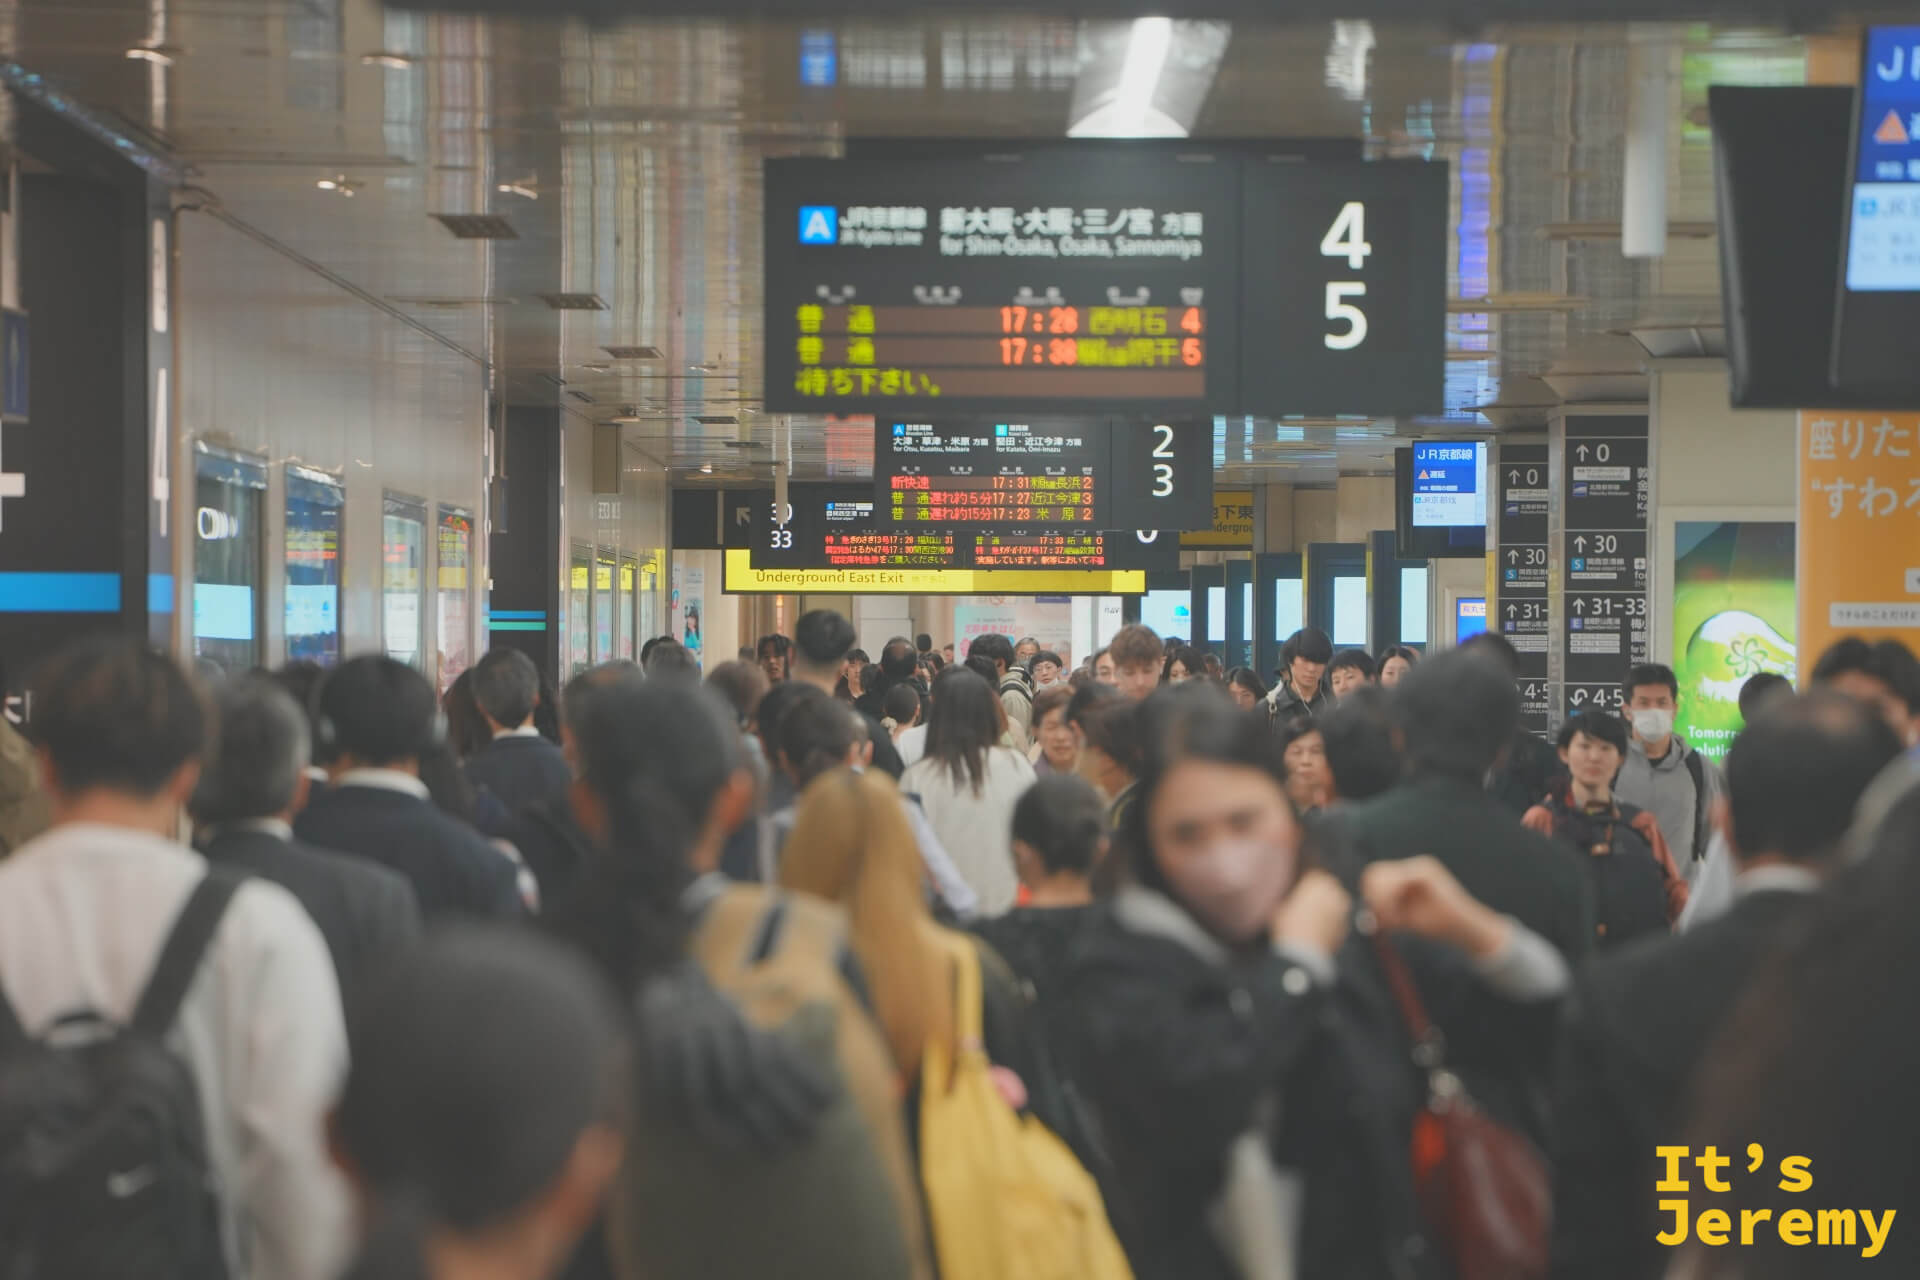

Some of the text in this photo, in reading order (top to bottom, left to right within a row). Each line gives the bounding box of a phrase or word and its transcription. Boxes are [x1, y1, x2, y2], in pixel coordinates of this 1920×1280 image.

[804, 211, 831, 239] A
[1320, 201, 1372, 269] 4
[1115, 235, 1202, 260] Sannomiya
[1181, 306, 1202, 334] 4
[1324, 281, 1368, 349] 5
[795, 368, 940, 396] 待ち下さい。
[894, 425, 903, 435] A
[1808, 418, 1920, 460] 座りた
[1153, 425, 1174, 457] 2
[1596, 444, 1610, 462] 0
[993, 477, 1030, 489] 17:31
[1083, 477, 1092, 489] 2
[1153, 464, 1174, 496] 3
[1527, 469, 1538, 485] 0
[993, 493, 1030, 505] 17:27
[1030, 492, 1081, 505] 近江今津
[1083, 493, 1092, 505] 3
[993, 508, 1030, 520] 17:23
[1083, 508, 1092, 520] 2
[770, 530, 793, 549] 33
[1594, 535, 1617, 554] 30
[1526, 549, 1546, 564] 30
[756, 571, 904, 585] Underground East Exit
[1688, 725, 1741, 739] Tomorr
